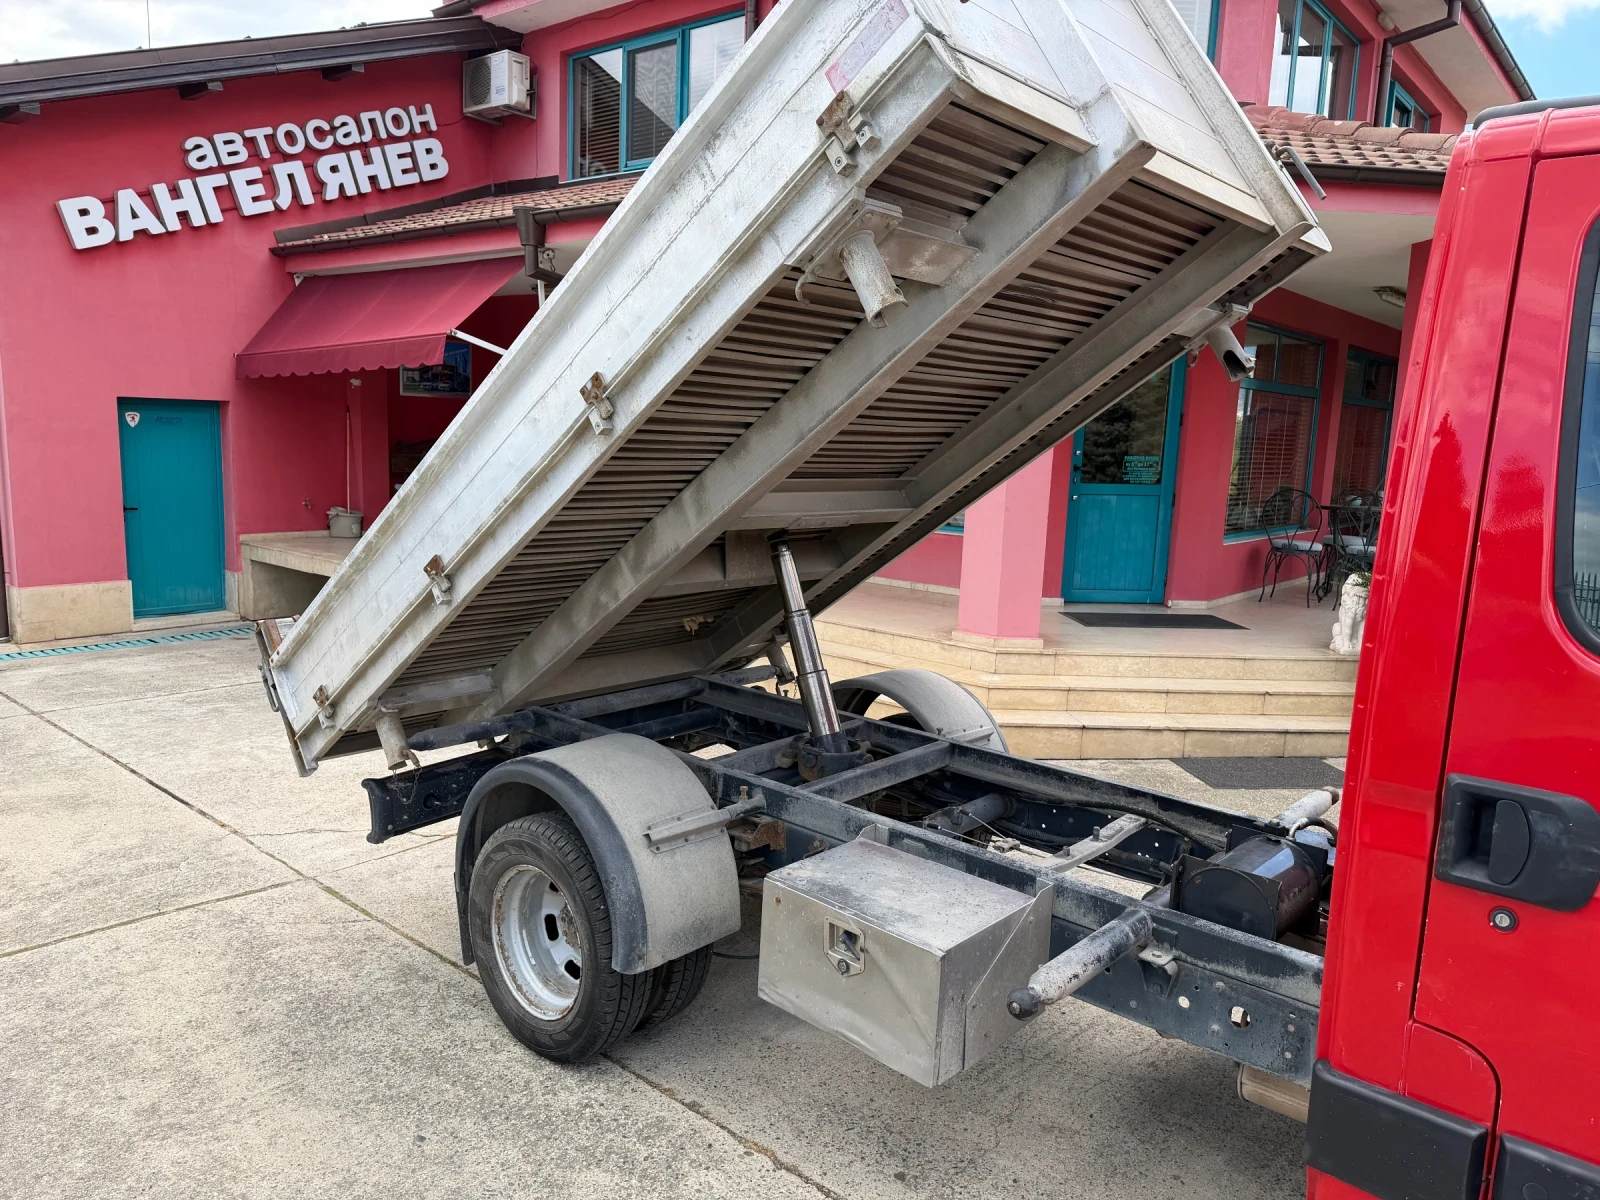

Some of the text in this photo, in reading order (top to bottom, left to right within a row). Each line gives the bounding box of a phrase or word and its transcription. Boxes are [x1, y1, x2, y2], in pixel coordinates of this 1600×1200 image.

[181, 103, 438, 170] автосалон
[57, 138, 449, 250] ВАНГЕЛ ЯНЕВ
